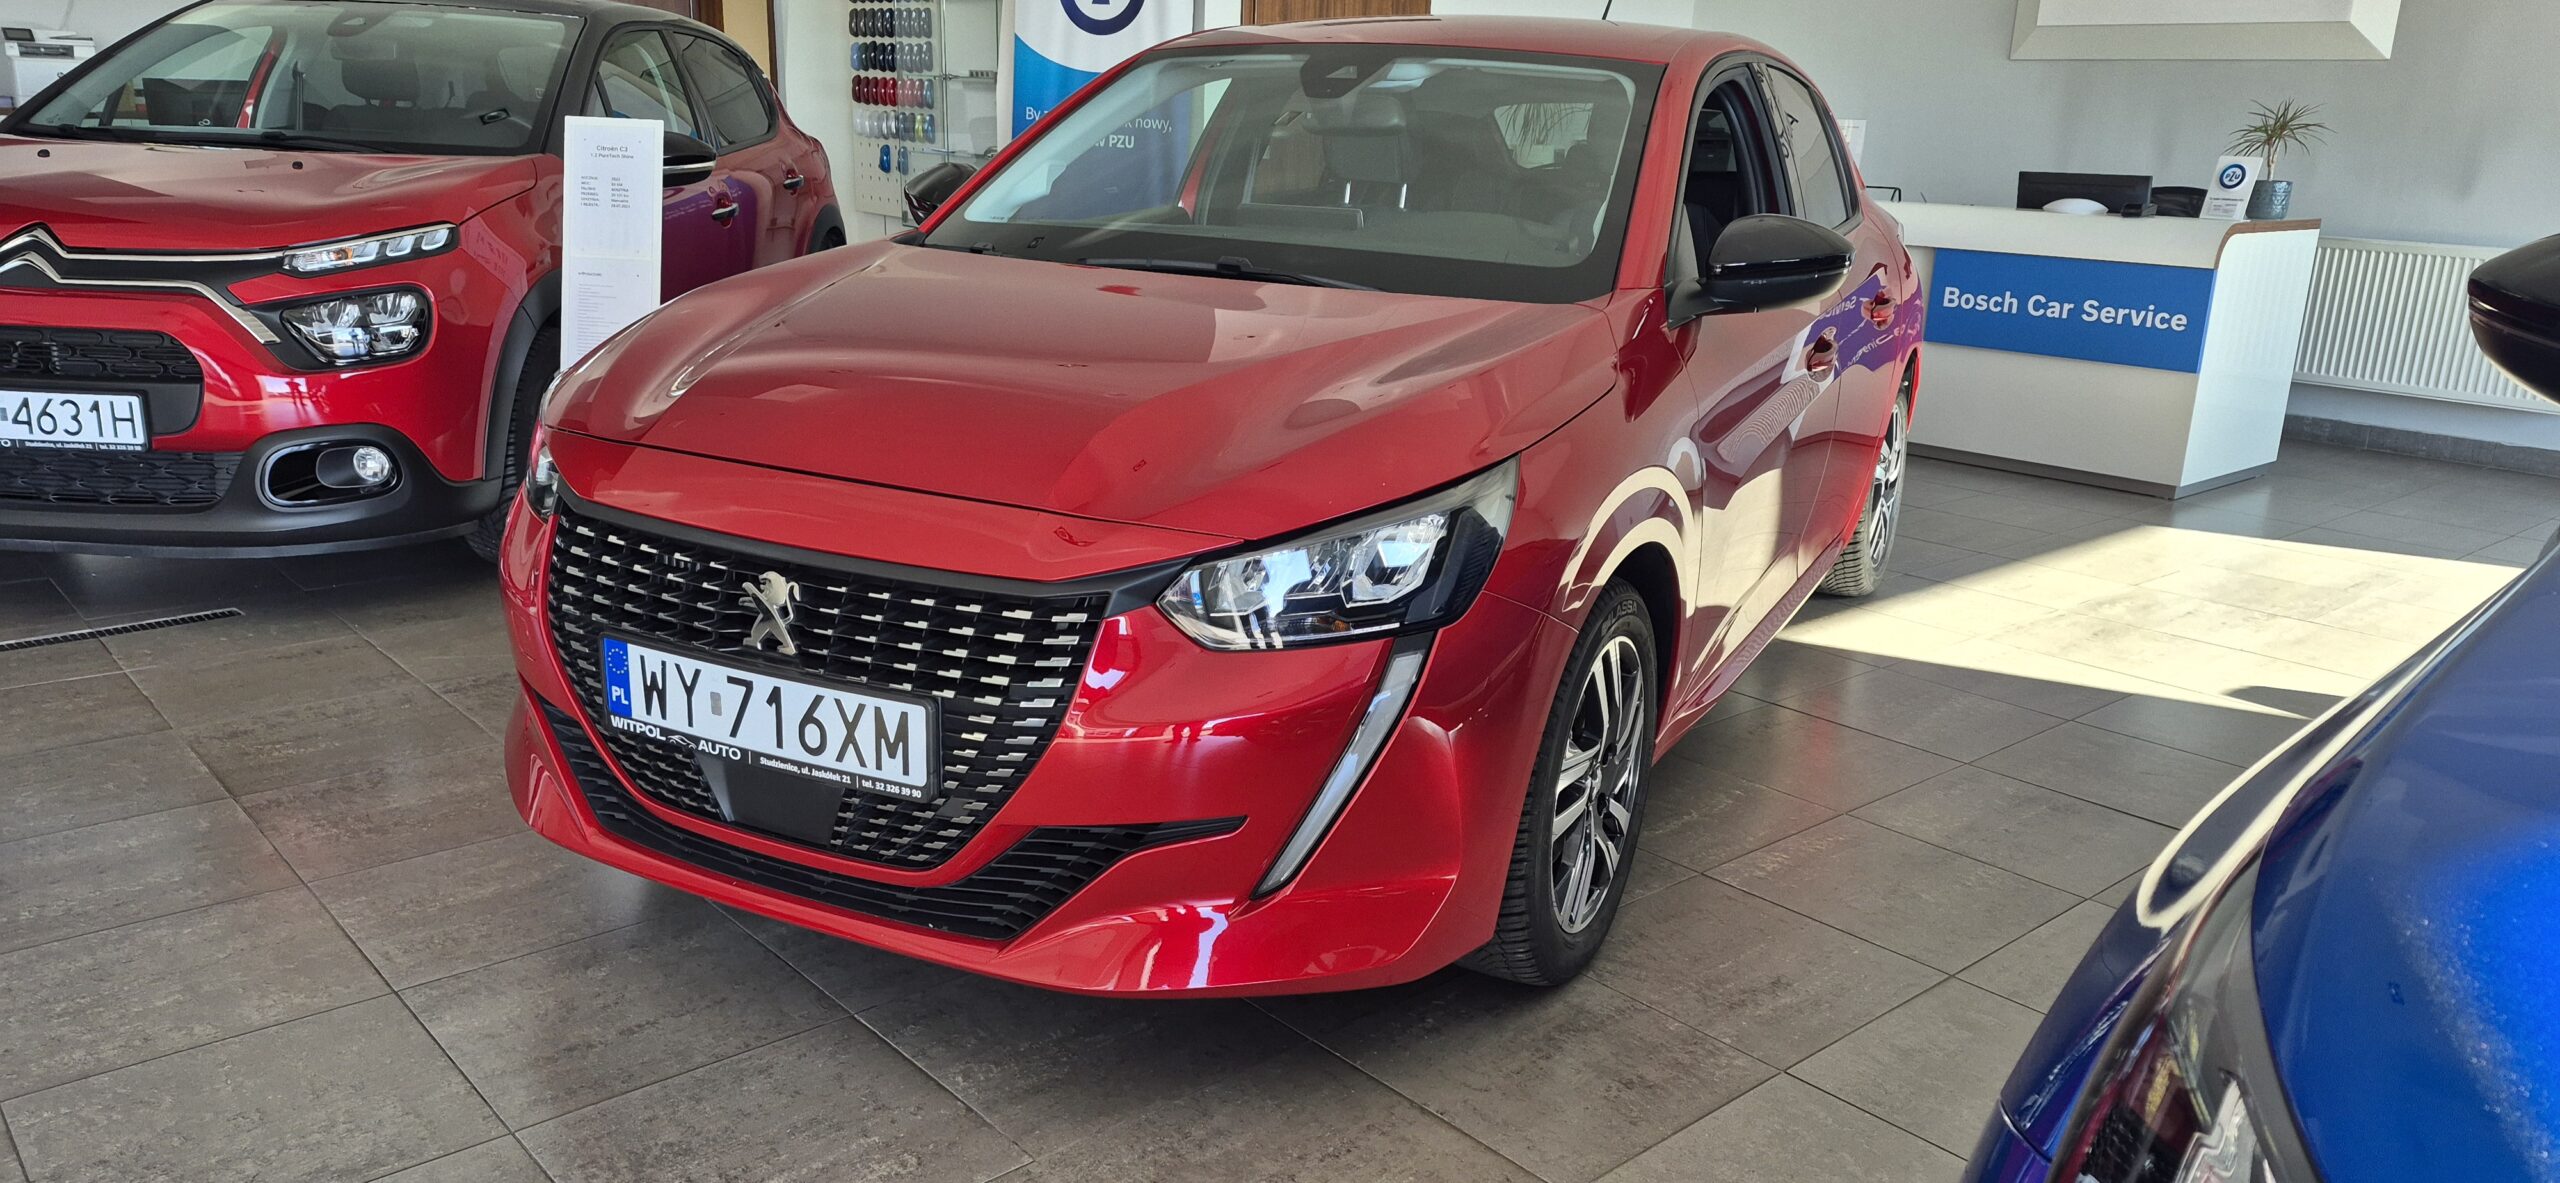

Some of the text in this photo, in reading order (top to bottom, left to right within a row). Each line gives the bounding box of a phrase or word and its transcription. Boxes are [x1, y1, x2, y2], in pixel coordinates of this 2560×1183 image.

[1135, 118, 1173, 134] nowy,
[1109, 134, 1135, 149] PZU
[2225, 171, 2241, 182] PZU
[1943, 286, 2188, 332] Bosch Car Service
[11, 396, 137, 439] 4631H
[611, 685, 629, 706] PL
[639, 654, 911, 777] WY 716XM
[610, 714, 742, 761] WITPOL AUTO
[842, 775, 852, 784] 21
[862, 779, 922, 798] tel. 32 326 39 90
